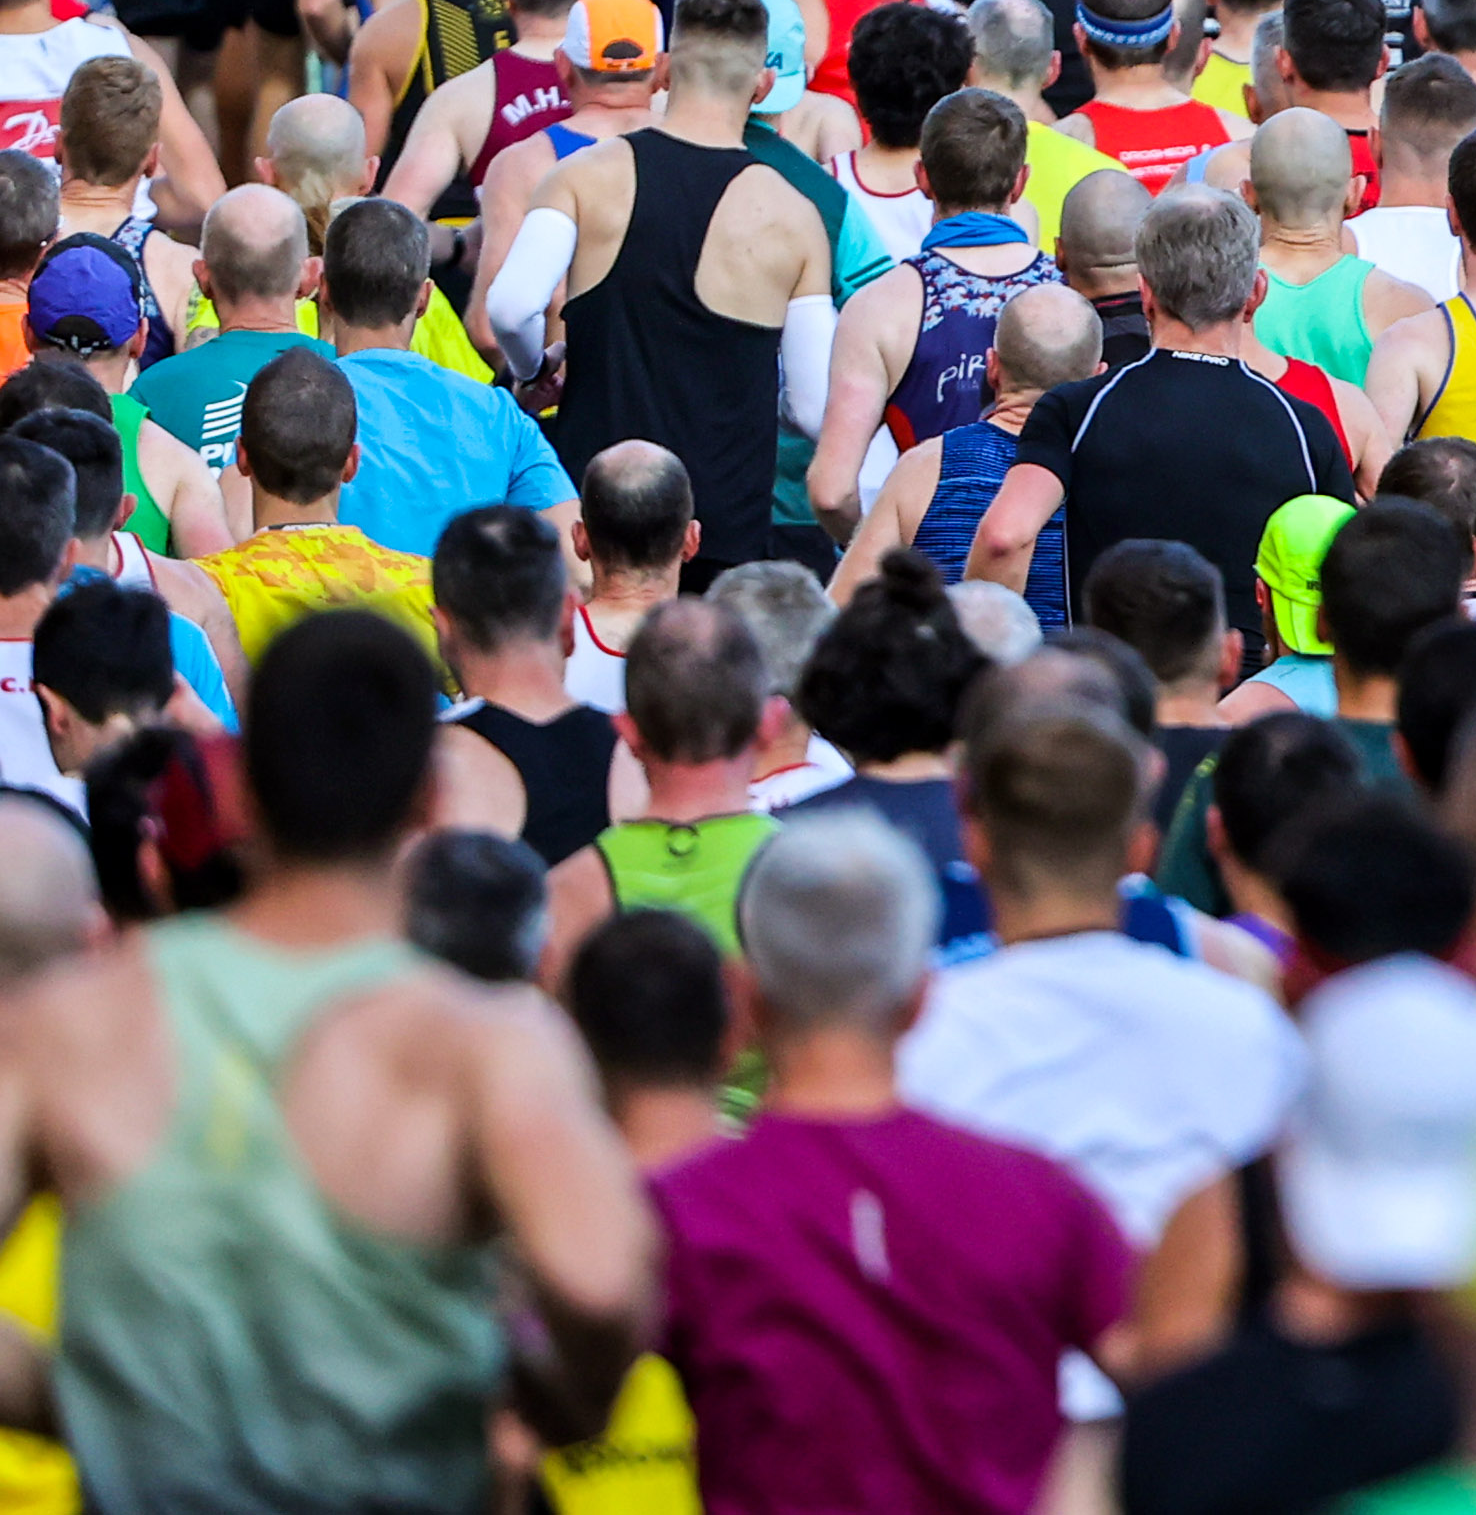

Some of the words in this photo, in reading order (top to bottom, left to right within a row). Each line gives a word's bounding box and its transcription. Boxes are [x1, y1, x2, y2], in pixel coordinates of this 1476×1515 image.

[1119, 145, 1197, 162] DROGHEDA
[1171, 350, 1202, 362] NIKE
[1202, 354, 1230, 367] PRO
